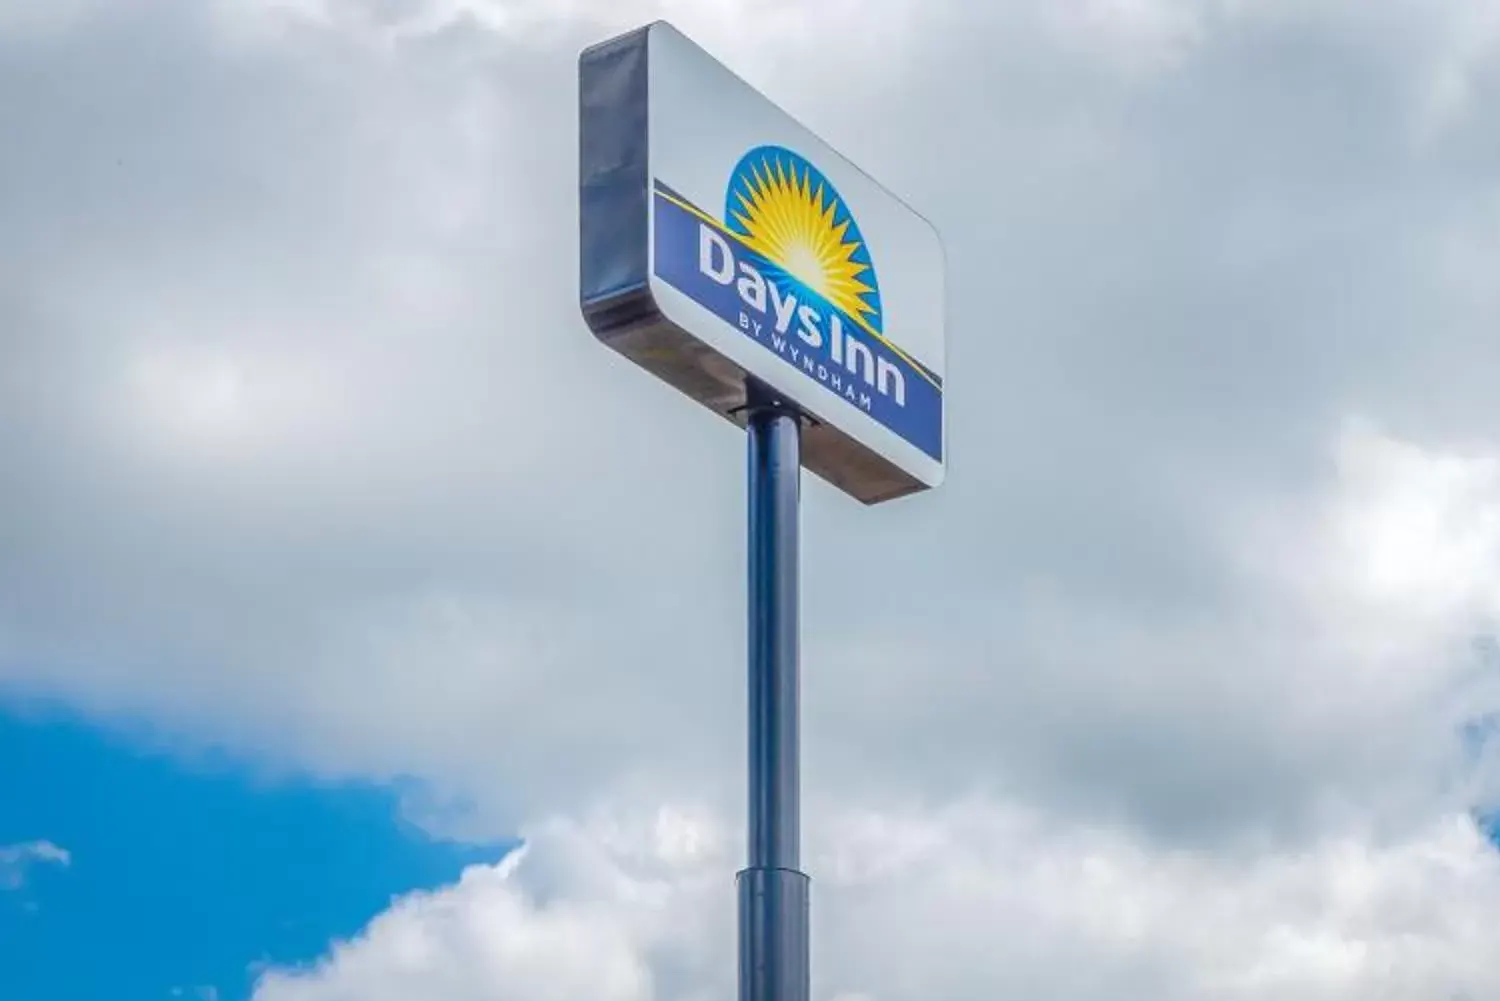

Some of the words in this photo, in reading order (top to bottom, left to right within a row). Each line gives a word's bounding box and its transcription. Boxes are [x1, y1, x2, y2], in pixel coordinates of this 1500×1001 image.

[700, 223, 823, 348] Days
[831, 314, 906, 408] Inn
[739, 311, 763, 337] BY
[771, 332, 872, 412] WYNDHAM
